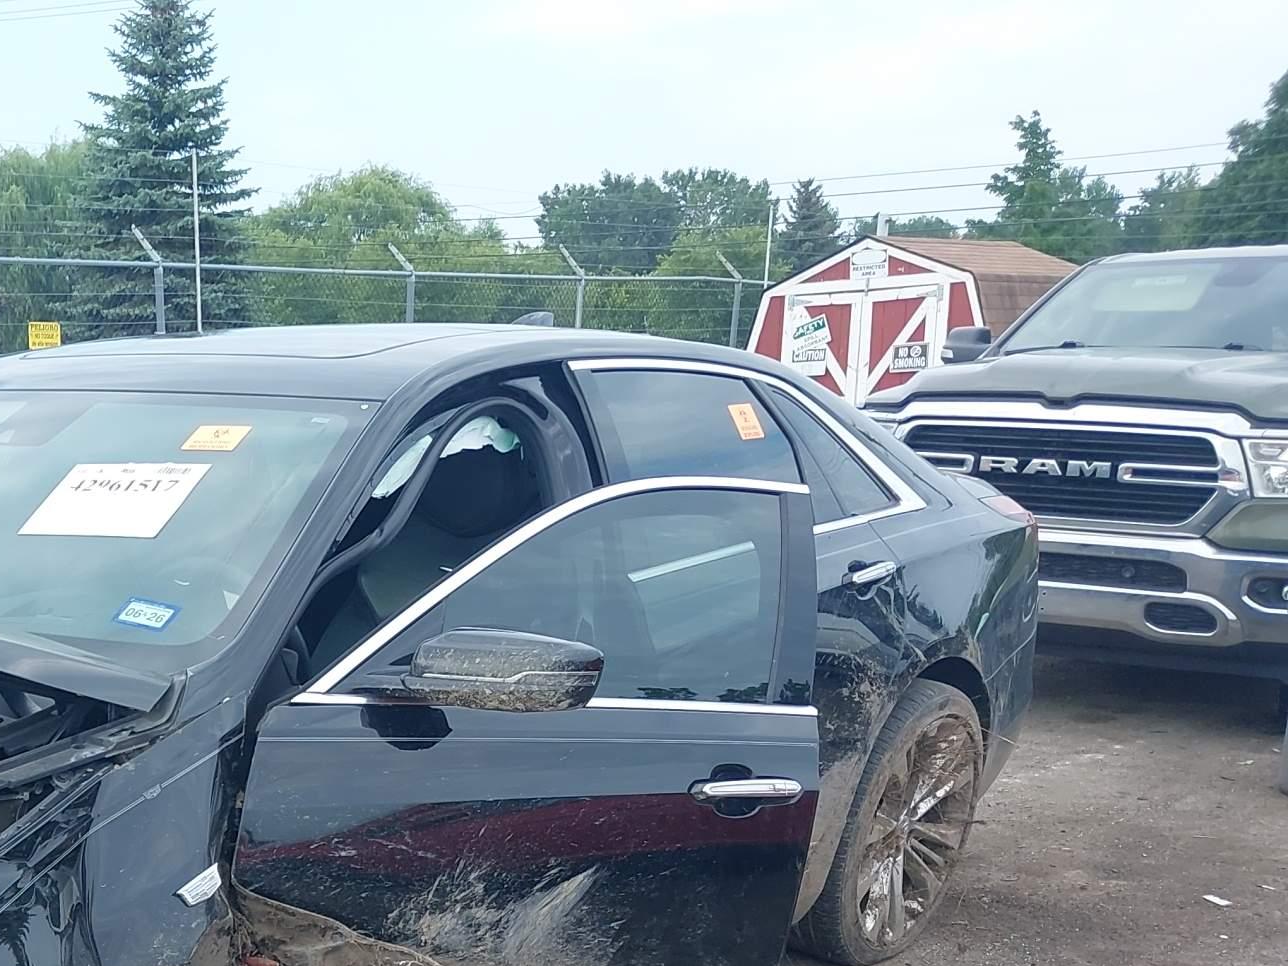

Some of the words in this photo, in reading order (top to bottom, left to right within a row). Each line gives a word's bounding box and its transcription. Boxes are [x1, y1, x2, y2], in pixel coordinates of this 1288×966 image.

[793, 350, 824, 361] CAUTION
[898, 346, 909, 358] NO
[894, 356, 926, 369] SMOKING
[978, 456, 1111, 478] RAM
[70, 479, 180, 492] 42961517
